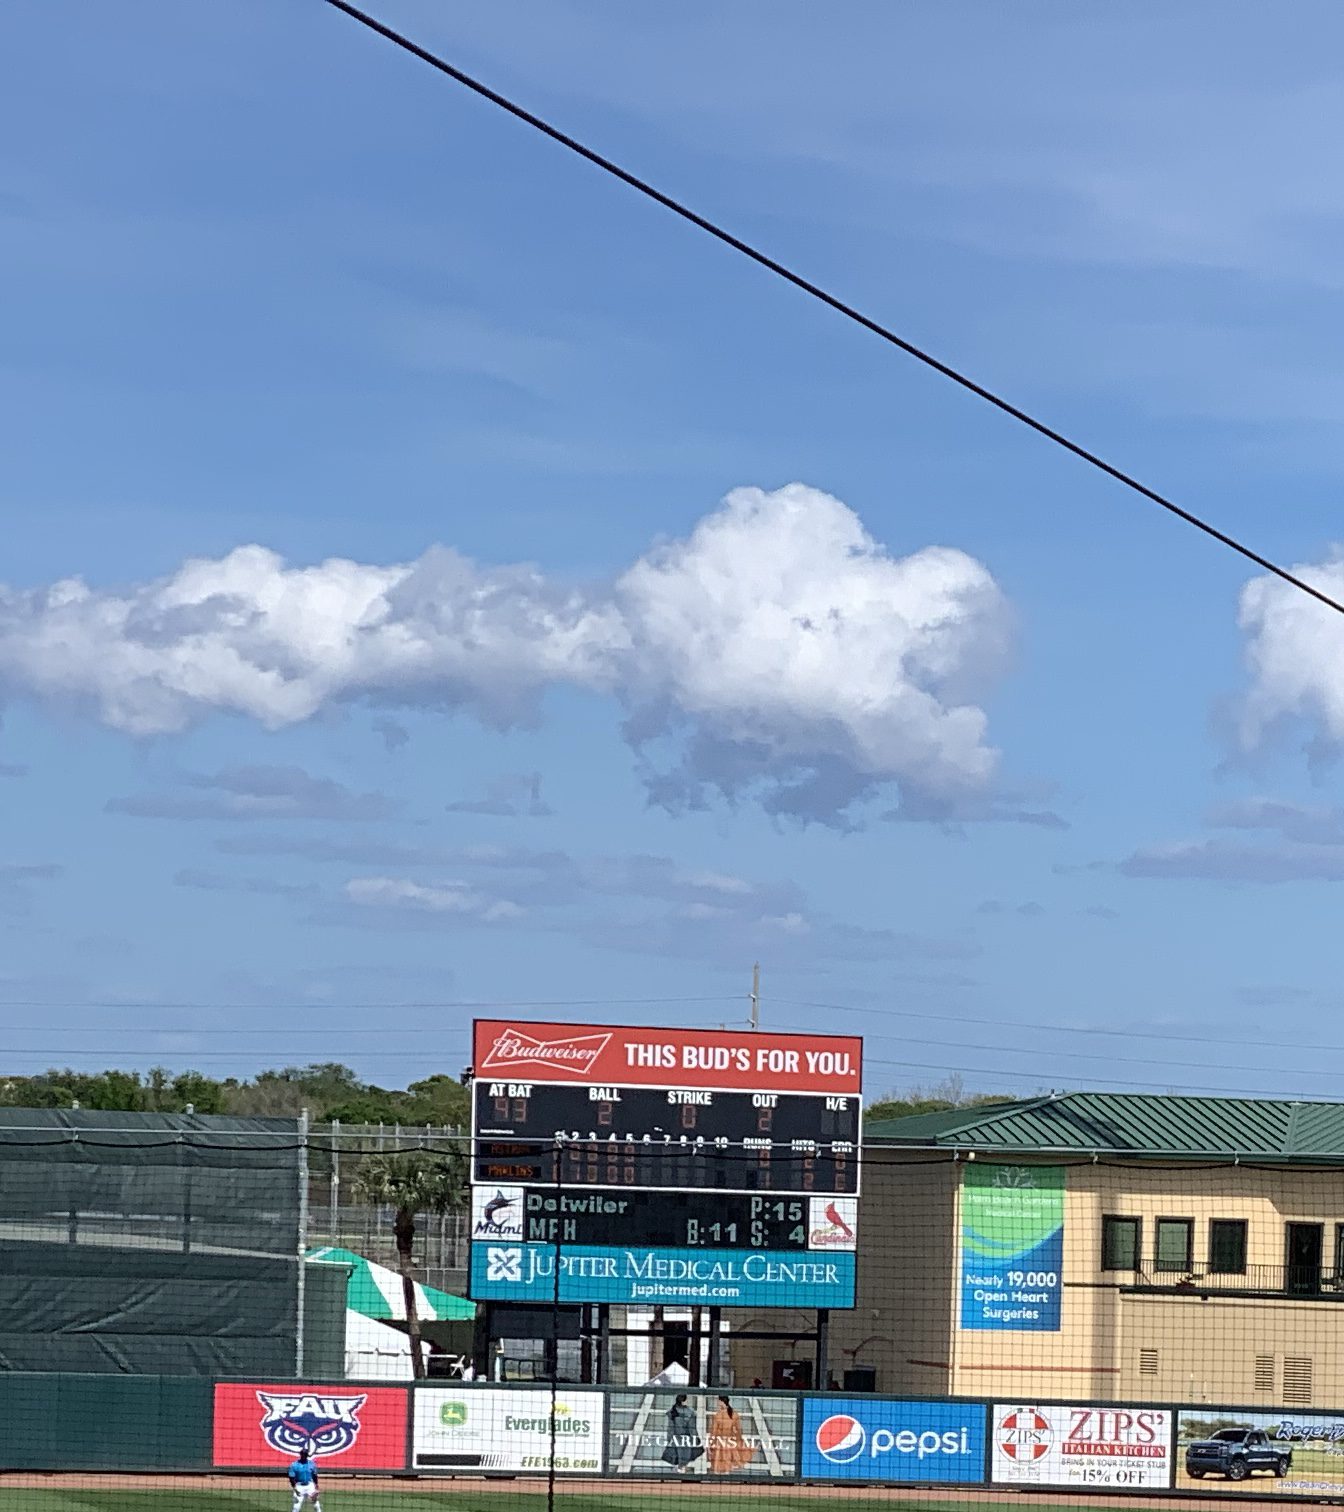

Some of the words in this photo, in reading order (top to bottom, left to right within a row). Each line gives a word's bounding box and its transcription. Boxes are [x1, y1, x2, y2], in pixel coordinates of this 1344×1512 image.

[493, 1038, 597, 1060] Budweiser
[624, 1043, 676, 1067] THIS
[682, 1045, 750, 1071] BUD'S
[756, 1049, 799, 1074] FOR
[805, 1051, 857, 1076] YOU.
[489, 1084, 505, 1097] AT
[508, 1084, 533, 1098] BAT
[589, 1088, 621, 1101] BALL
[667, 1091, 712, 1105] STRIKE
[752, 1094, 778, 1108] OUT
[826, 1097, 847, 1111] H/E
[682, 1105, 697, 1129] 0
[474, 1220, 522, 1236] Miami
[525, 1248, 619, 1284] JUPITER
[624, 1251, 741, 1282] MEDICAL
[743, 1254, 839, 1284] CENTER
[966, 1273, 1003, 1289] Nearly
[1007, 1271, 1057, 1288] 19,000
[631, 1281, 740, 1298] jupitermed.com
[974, 1289, 1008, 1305] Open
[1012, 1291, 1048, 1304] Heart
[983, 1306, 1039, 1322] Surgeries
[260, 1396, 365, 1423] FAU
[505, 1415, 590, 1434] Everglades
[1068, 1410, 1165, 1443] ZIPS'
[1276, 1421, 1331, 1443] Roger
[615, 1433, 651, 1447] THE
[655, 1434, 737, 1449] GARDENS
[742, 1436, 790, 1450] MALL
[871, 1427, 968, 1461] pepsi
[1005, 1429, 1046, 1445] ZIPS'
[1063, 1443, 1110, 1456] ITALIAN
[1114, 1445, 1165, 1458] KITCHEN
[1082, 1470, 1110, 1483] 15%
[1116, 1470, 1147, 1484] OFF
